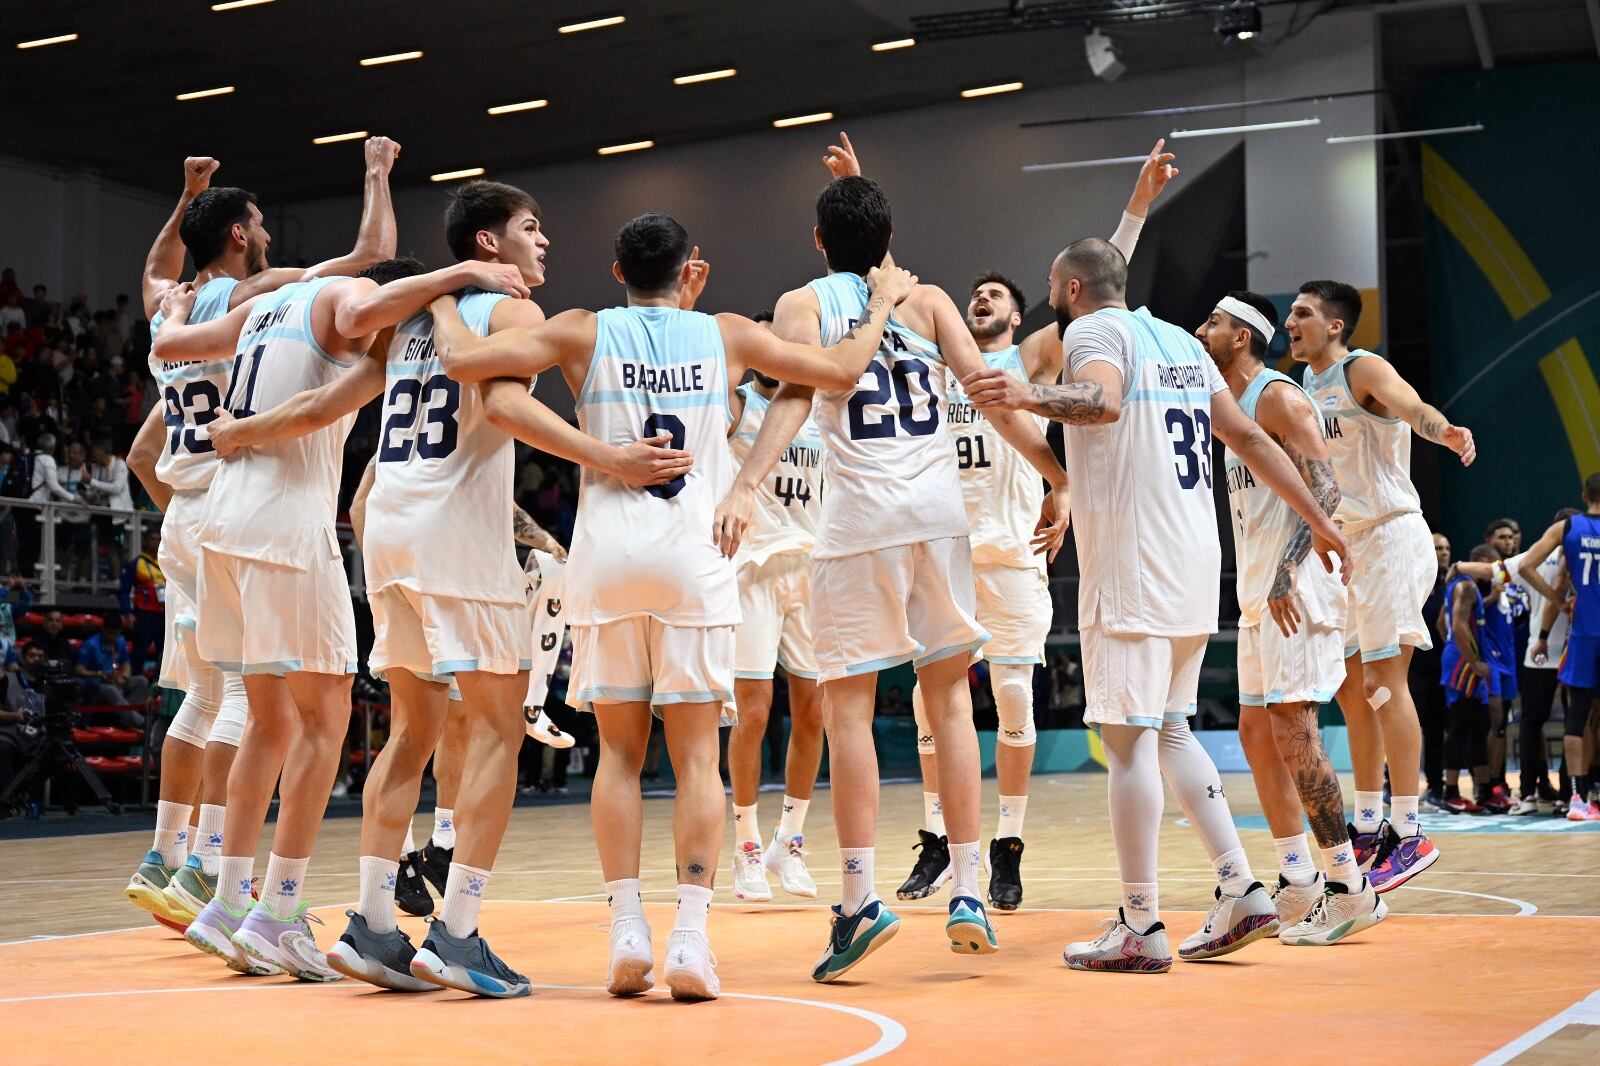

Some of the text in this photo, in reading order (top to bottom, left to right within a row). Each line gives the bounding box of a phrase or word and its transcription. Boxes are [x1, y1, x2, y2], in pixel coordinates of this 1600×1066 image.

[622, 363, 703, 394] BARALLE
[848, 358, 939, 440] 20
[163, 380, 221, 454] 93
[379, 374, 460, 463] 23
[947, 403, 985, 423] RGEN
[955, 435, 991, 469] 91
[1164, 408, 1211, 489] 33
[775, 476, 811, 509] 44
